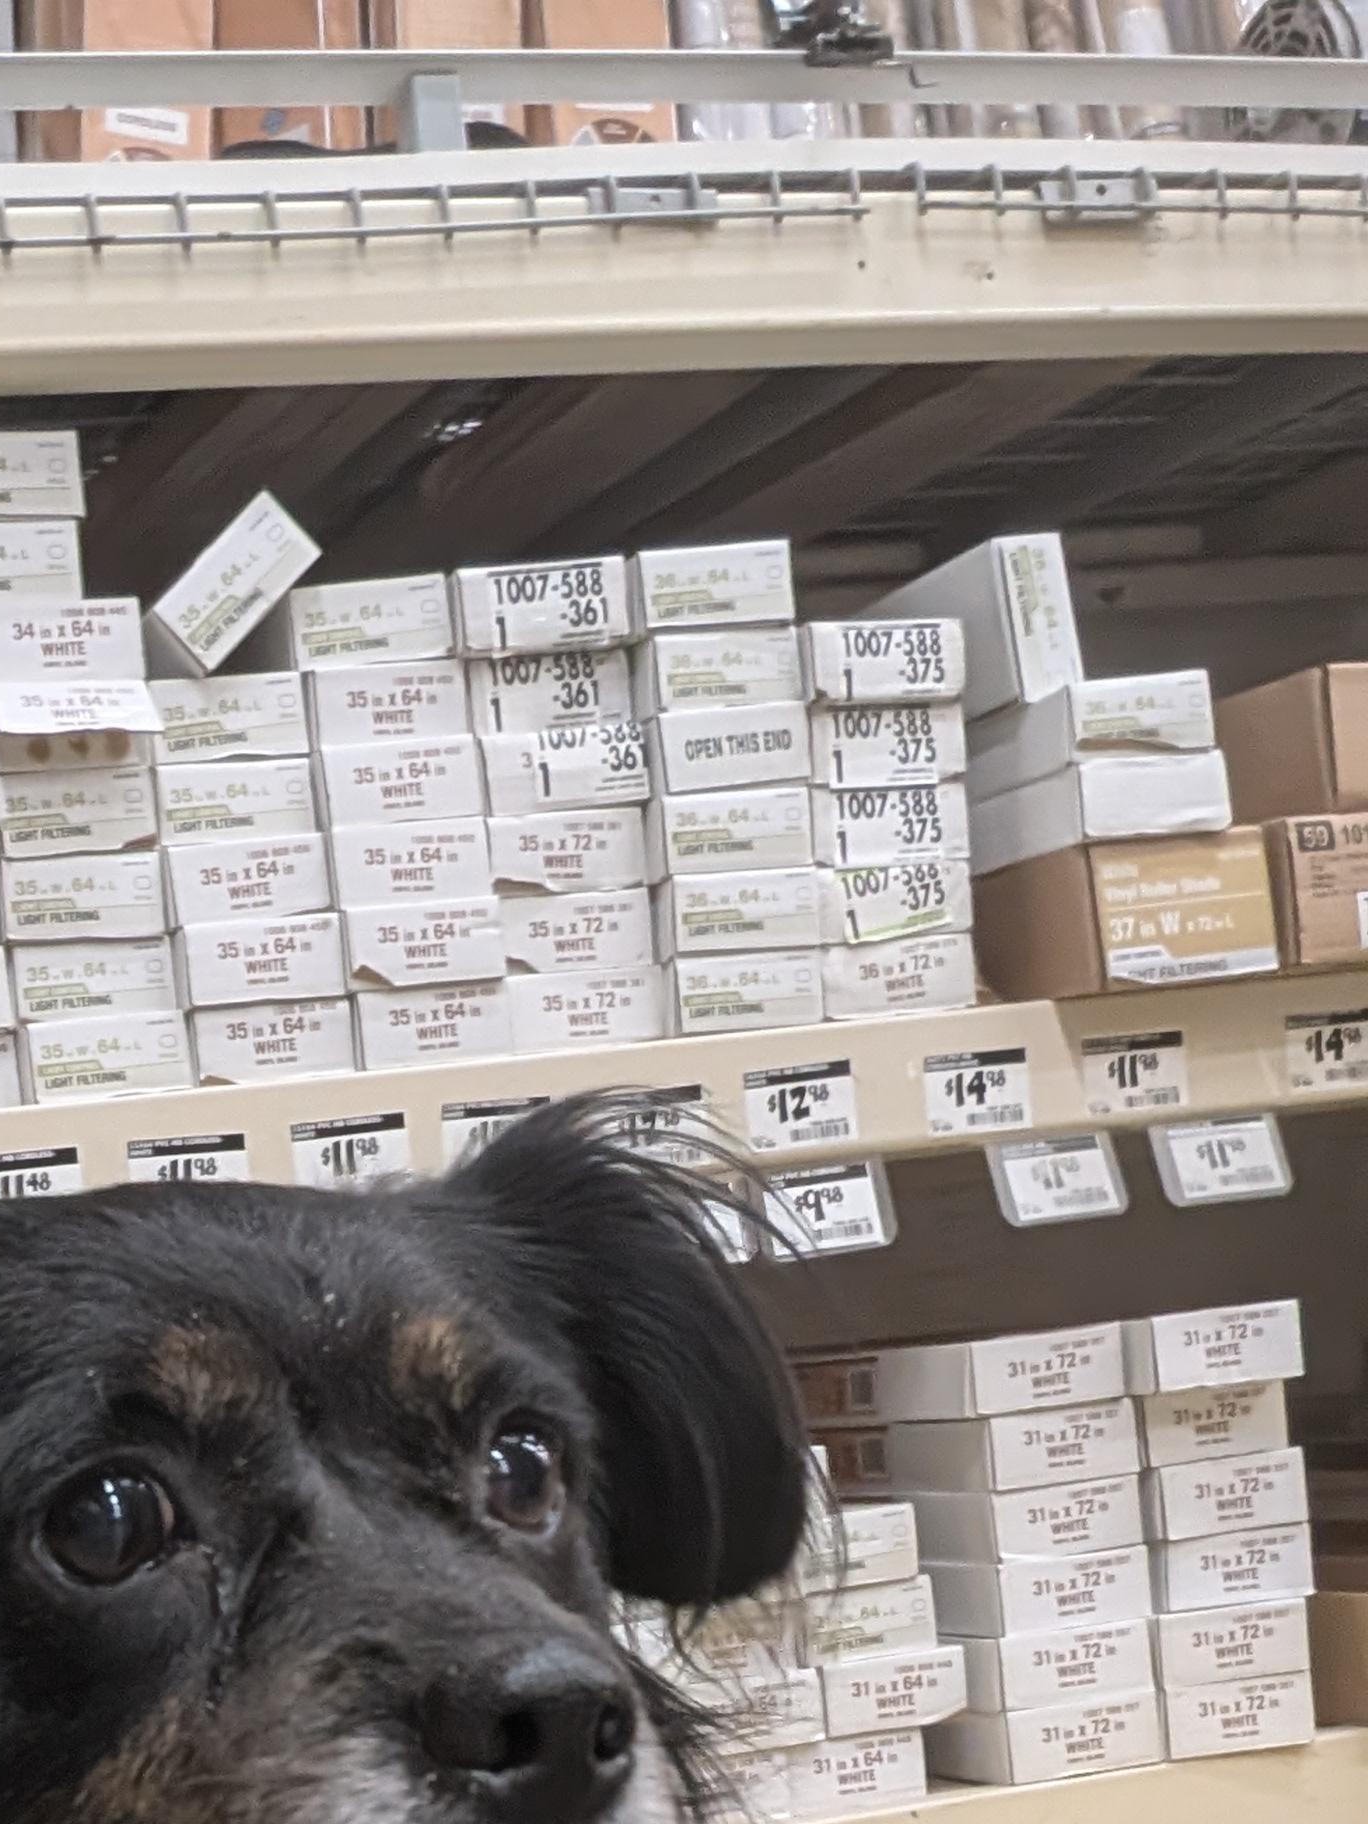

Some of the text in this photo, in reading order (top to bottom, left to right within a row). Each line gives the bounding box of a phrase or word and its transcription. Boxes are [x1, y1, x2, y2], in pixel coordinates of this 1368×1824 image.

[494, 569, 602, 604] 1007-588
[561, 598, 609, 627] -361
[12, 623, 35, 639] 34
[40, 625, 52, 638] in
[71, 620, 94, 637] 64
[99, 624, 110, 635] in
[495, 617, 506, 649] 1
[40, 642, 86, 656] WHITE
[843, 630, 941, 657] 1007-588
[491, 652, 594, 685] 1007-588
[899, 658, 945, 683] -375
[554, 681, 599, 709] -361
[844, 669, 852, 699] 1
[490, 698, 502, 732] 1
[833, 710, 931, 738] 1007-588
[602, 742, 648, 771] -361
[684, 729, 791, 761] OPEN THIS END
[889, 738, 935, 764] -375
[539, 762, 550, 796] 1
[833, 750, 843, 783] 1
[837, 791, 938, 819] 1007-588
[10, 826, 90, 843] LIGHT FILTERING
[519, 835, 539, 851] 35
[543, 840, 553, 850] in
[572, 835, 592, 850] 72
[597, 838, 606, 849] in
[895, 819, 941, 843] -375
[838, 831, 848, 863] 1
[200, 868, 221, 885] 35
[226, 869, 237, 882] in
[257, 862, 279, 878] 64
[283, 864, 295, 875] in
[544, 855, 583, 868] WHITE
[228, 883, 272, 899] WHITE
[900, 880, 945, 909] -375
[847, 910, 859, 939] 1
[1160, 912, 1180, 935] W
[1160, 960, 1228, 978] FILTERING
[885, 974, 924, 992] WHITE
[226, 1022, 248, 1039] 35
[252, 1025, 264, 1037] in
[283, 1018, 305, 1033] 64
[310, 1020, 321, 1031] in
[253, 1039, 297, 1054] WHITE
[1033, 1580, 1050, 1596] 31
[1054, 1581, 1064, 1592] in
[1081, 1573, 1101, 1587] 72
[1105, 1574, 1115, 1584] in
[1057, 1591, 1095, 1607] WHITE
[852, 1682, 870, 1697] 31
[875, 1682, 886, 1694] in
[903, 1675, 923, 1691] 64
[927, 1677, 937, 1687] in
[877, 1694, 915, 1707] WHITE
